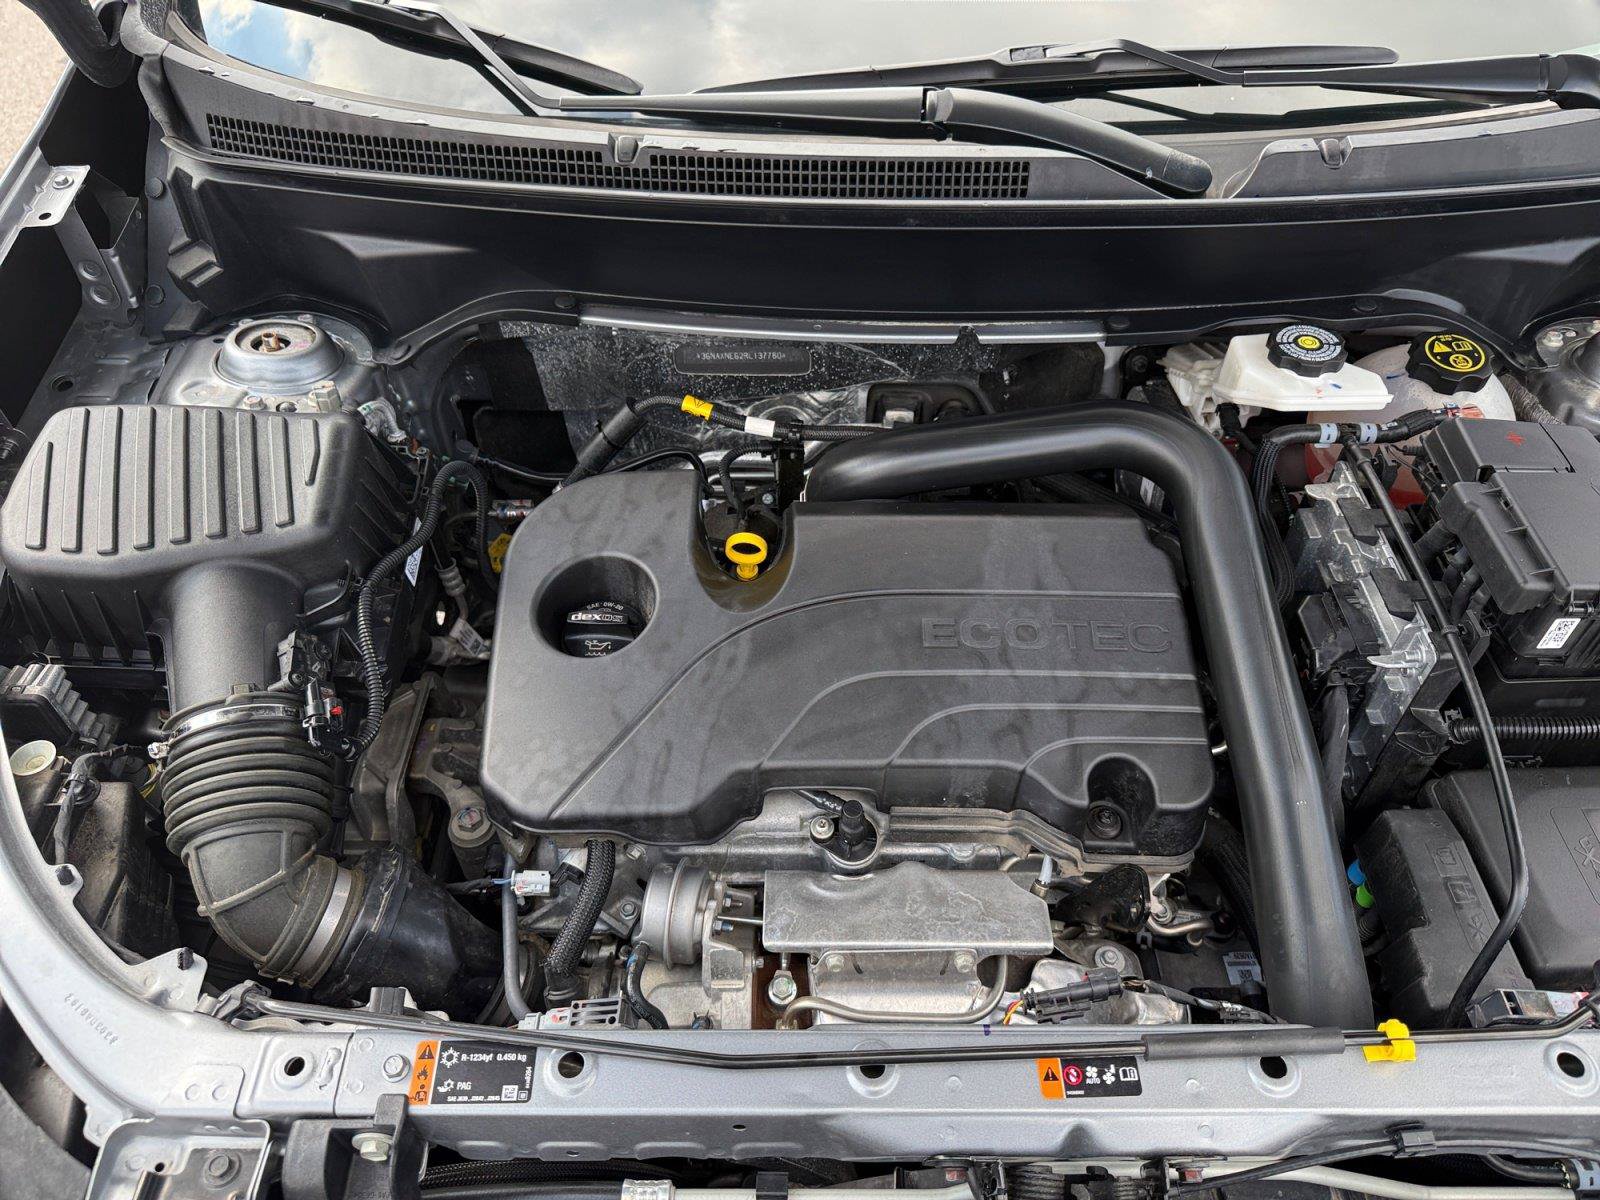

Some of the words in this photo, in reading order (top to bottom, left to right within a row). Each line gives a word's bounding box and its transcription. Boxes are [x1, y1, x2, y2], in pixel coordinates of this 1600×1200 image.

[921, 616, 1171, 652] ECOTEC
[497, 1053, 516, 1061] 0.450
[517, 1053, 527, 1063] kg
[456, 1081, 472, 1090] PAG
